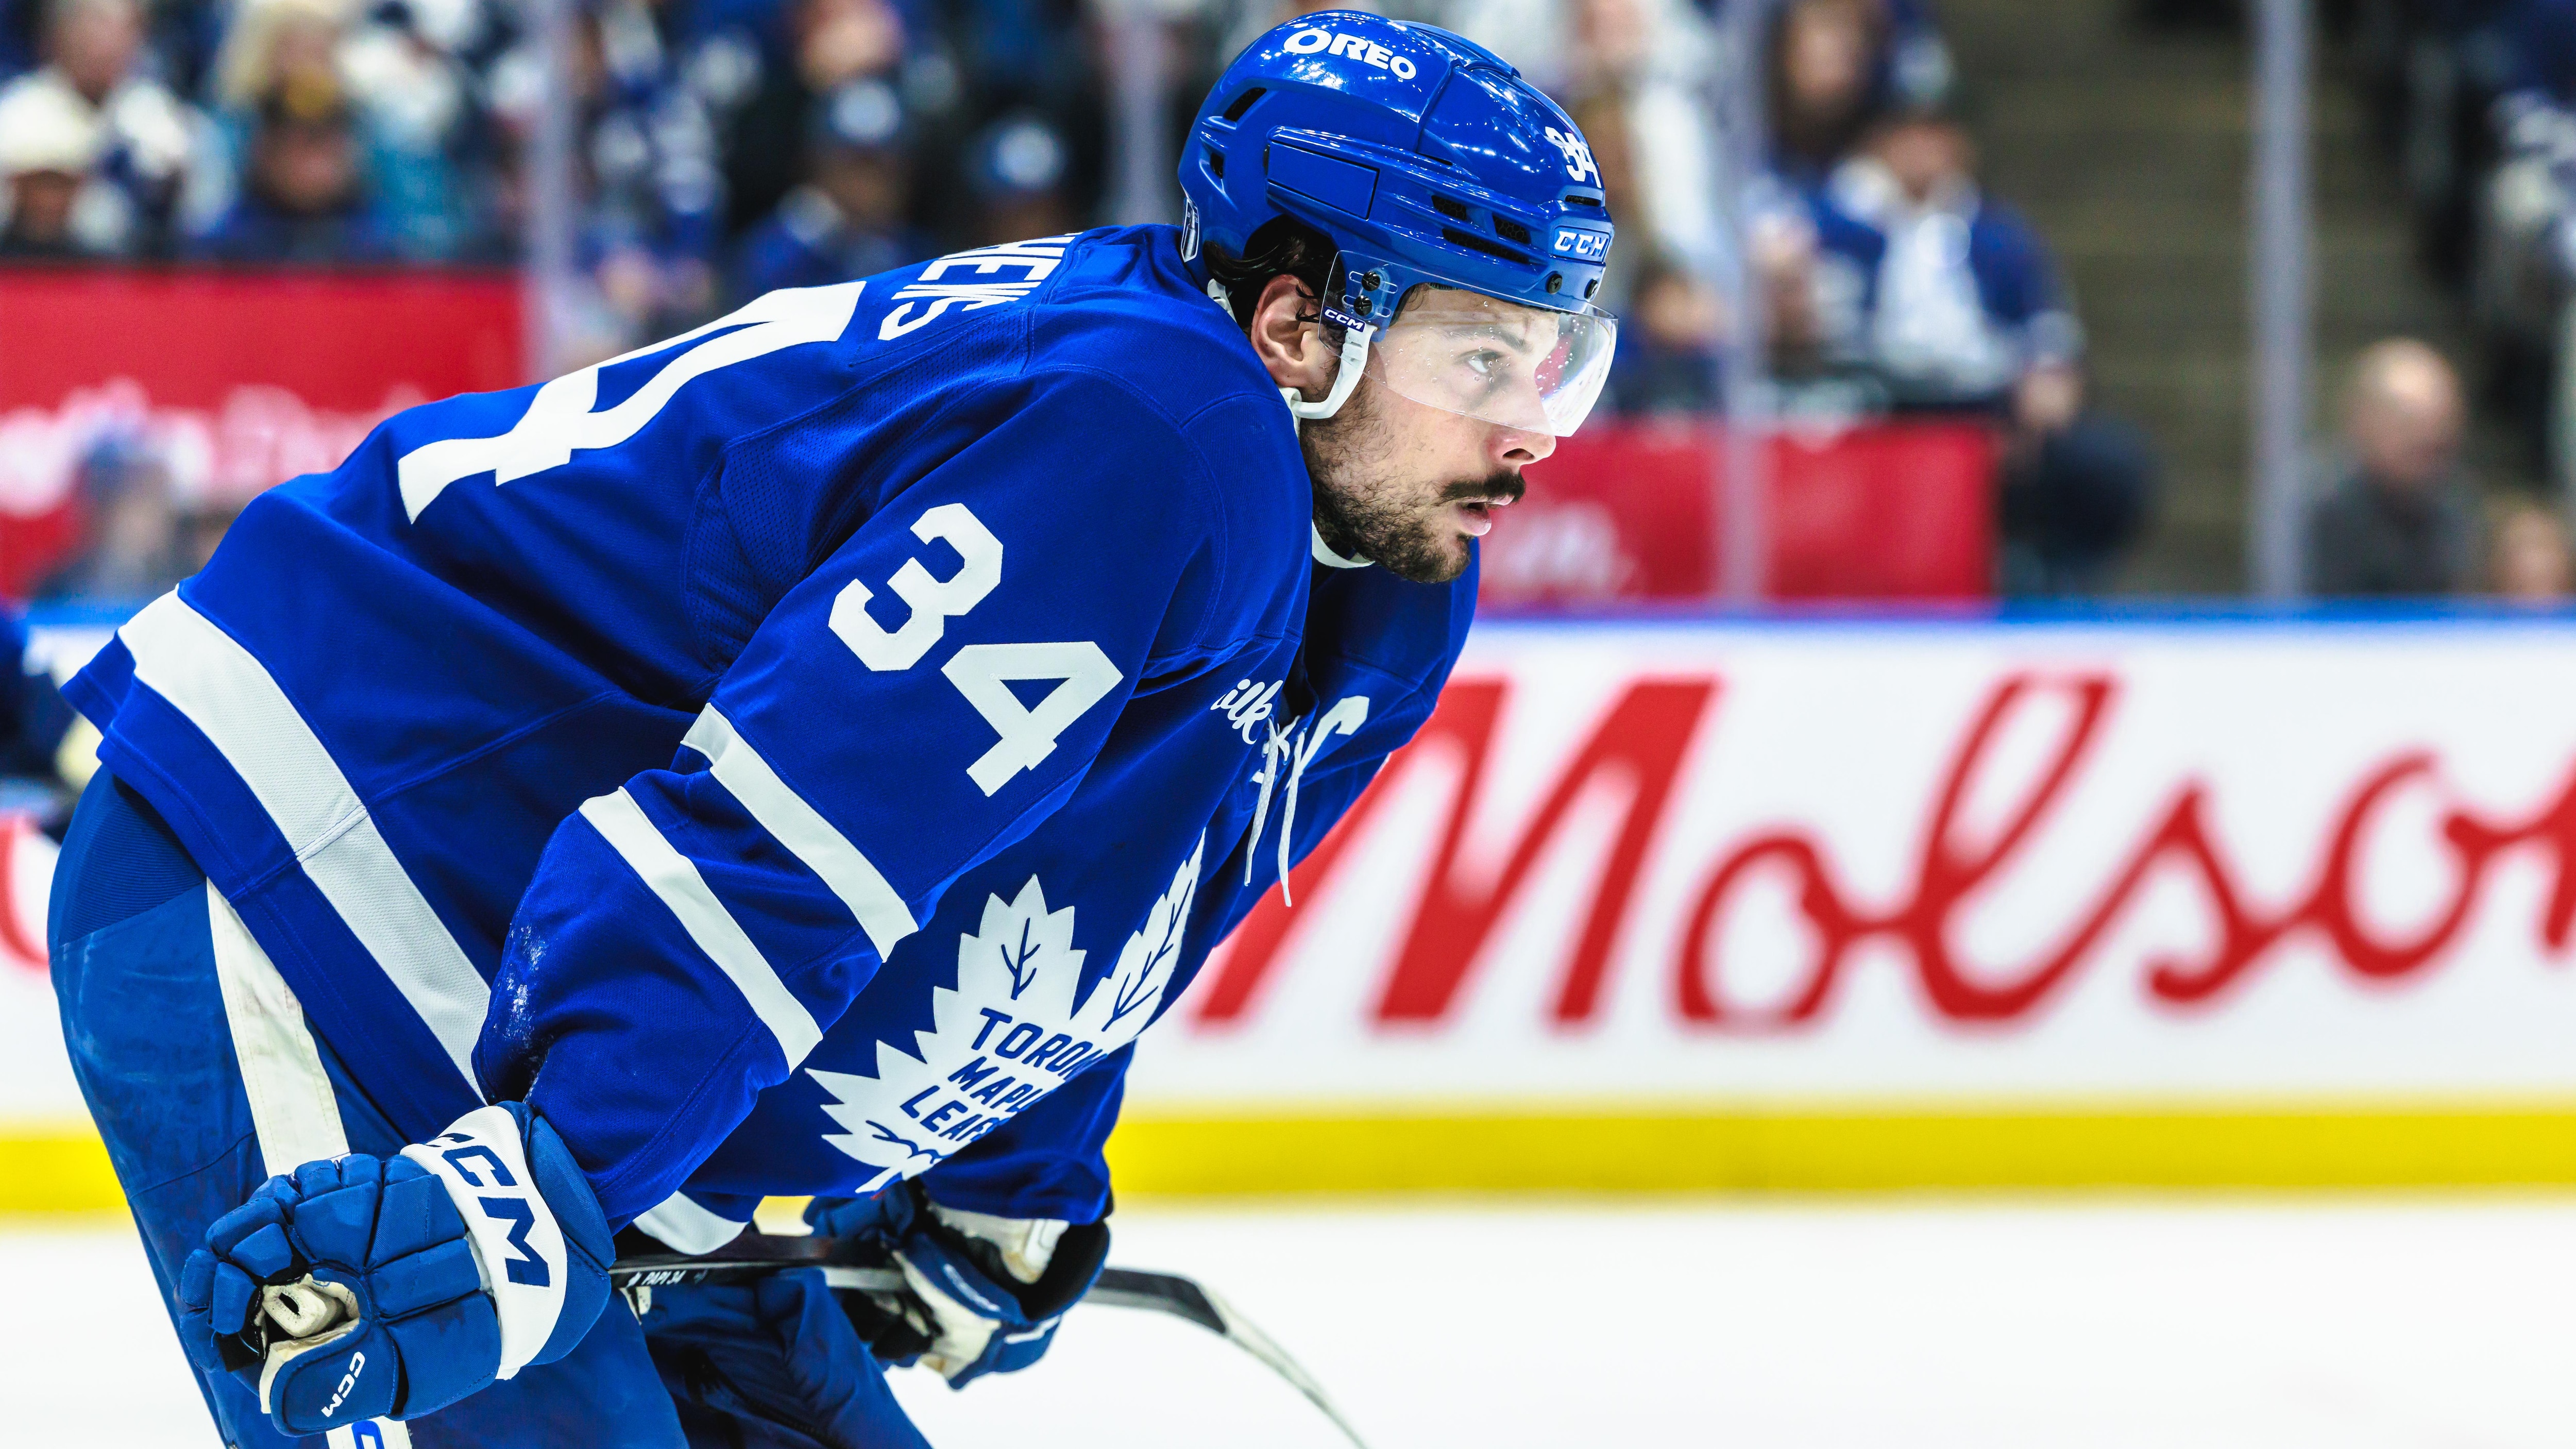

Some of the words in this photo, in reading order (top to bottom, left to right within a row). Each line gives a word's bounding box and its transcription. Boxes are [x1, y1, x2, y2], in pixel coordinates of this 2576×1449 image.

[1283, 28, 1416, 80] OREO
[1545, 126, 1602, 189] 34
[1554, 231, 1607, 257] CCM
[877, 232, 1083, 341] HEWS
[1325, 309, 1364, 330] CCM
[828, 502, 1124, 797] 34
[1210, 679, 1283, 745] ilk
[971, 1007, 1108, 1083] TORON
[947, 1056, 1051, 1113] MAPL
[321, 1351, 365, 1417] CCM
